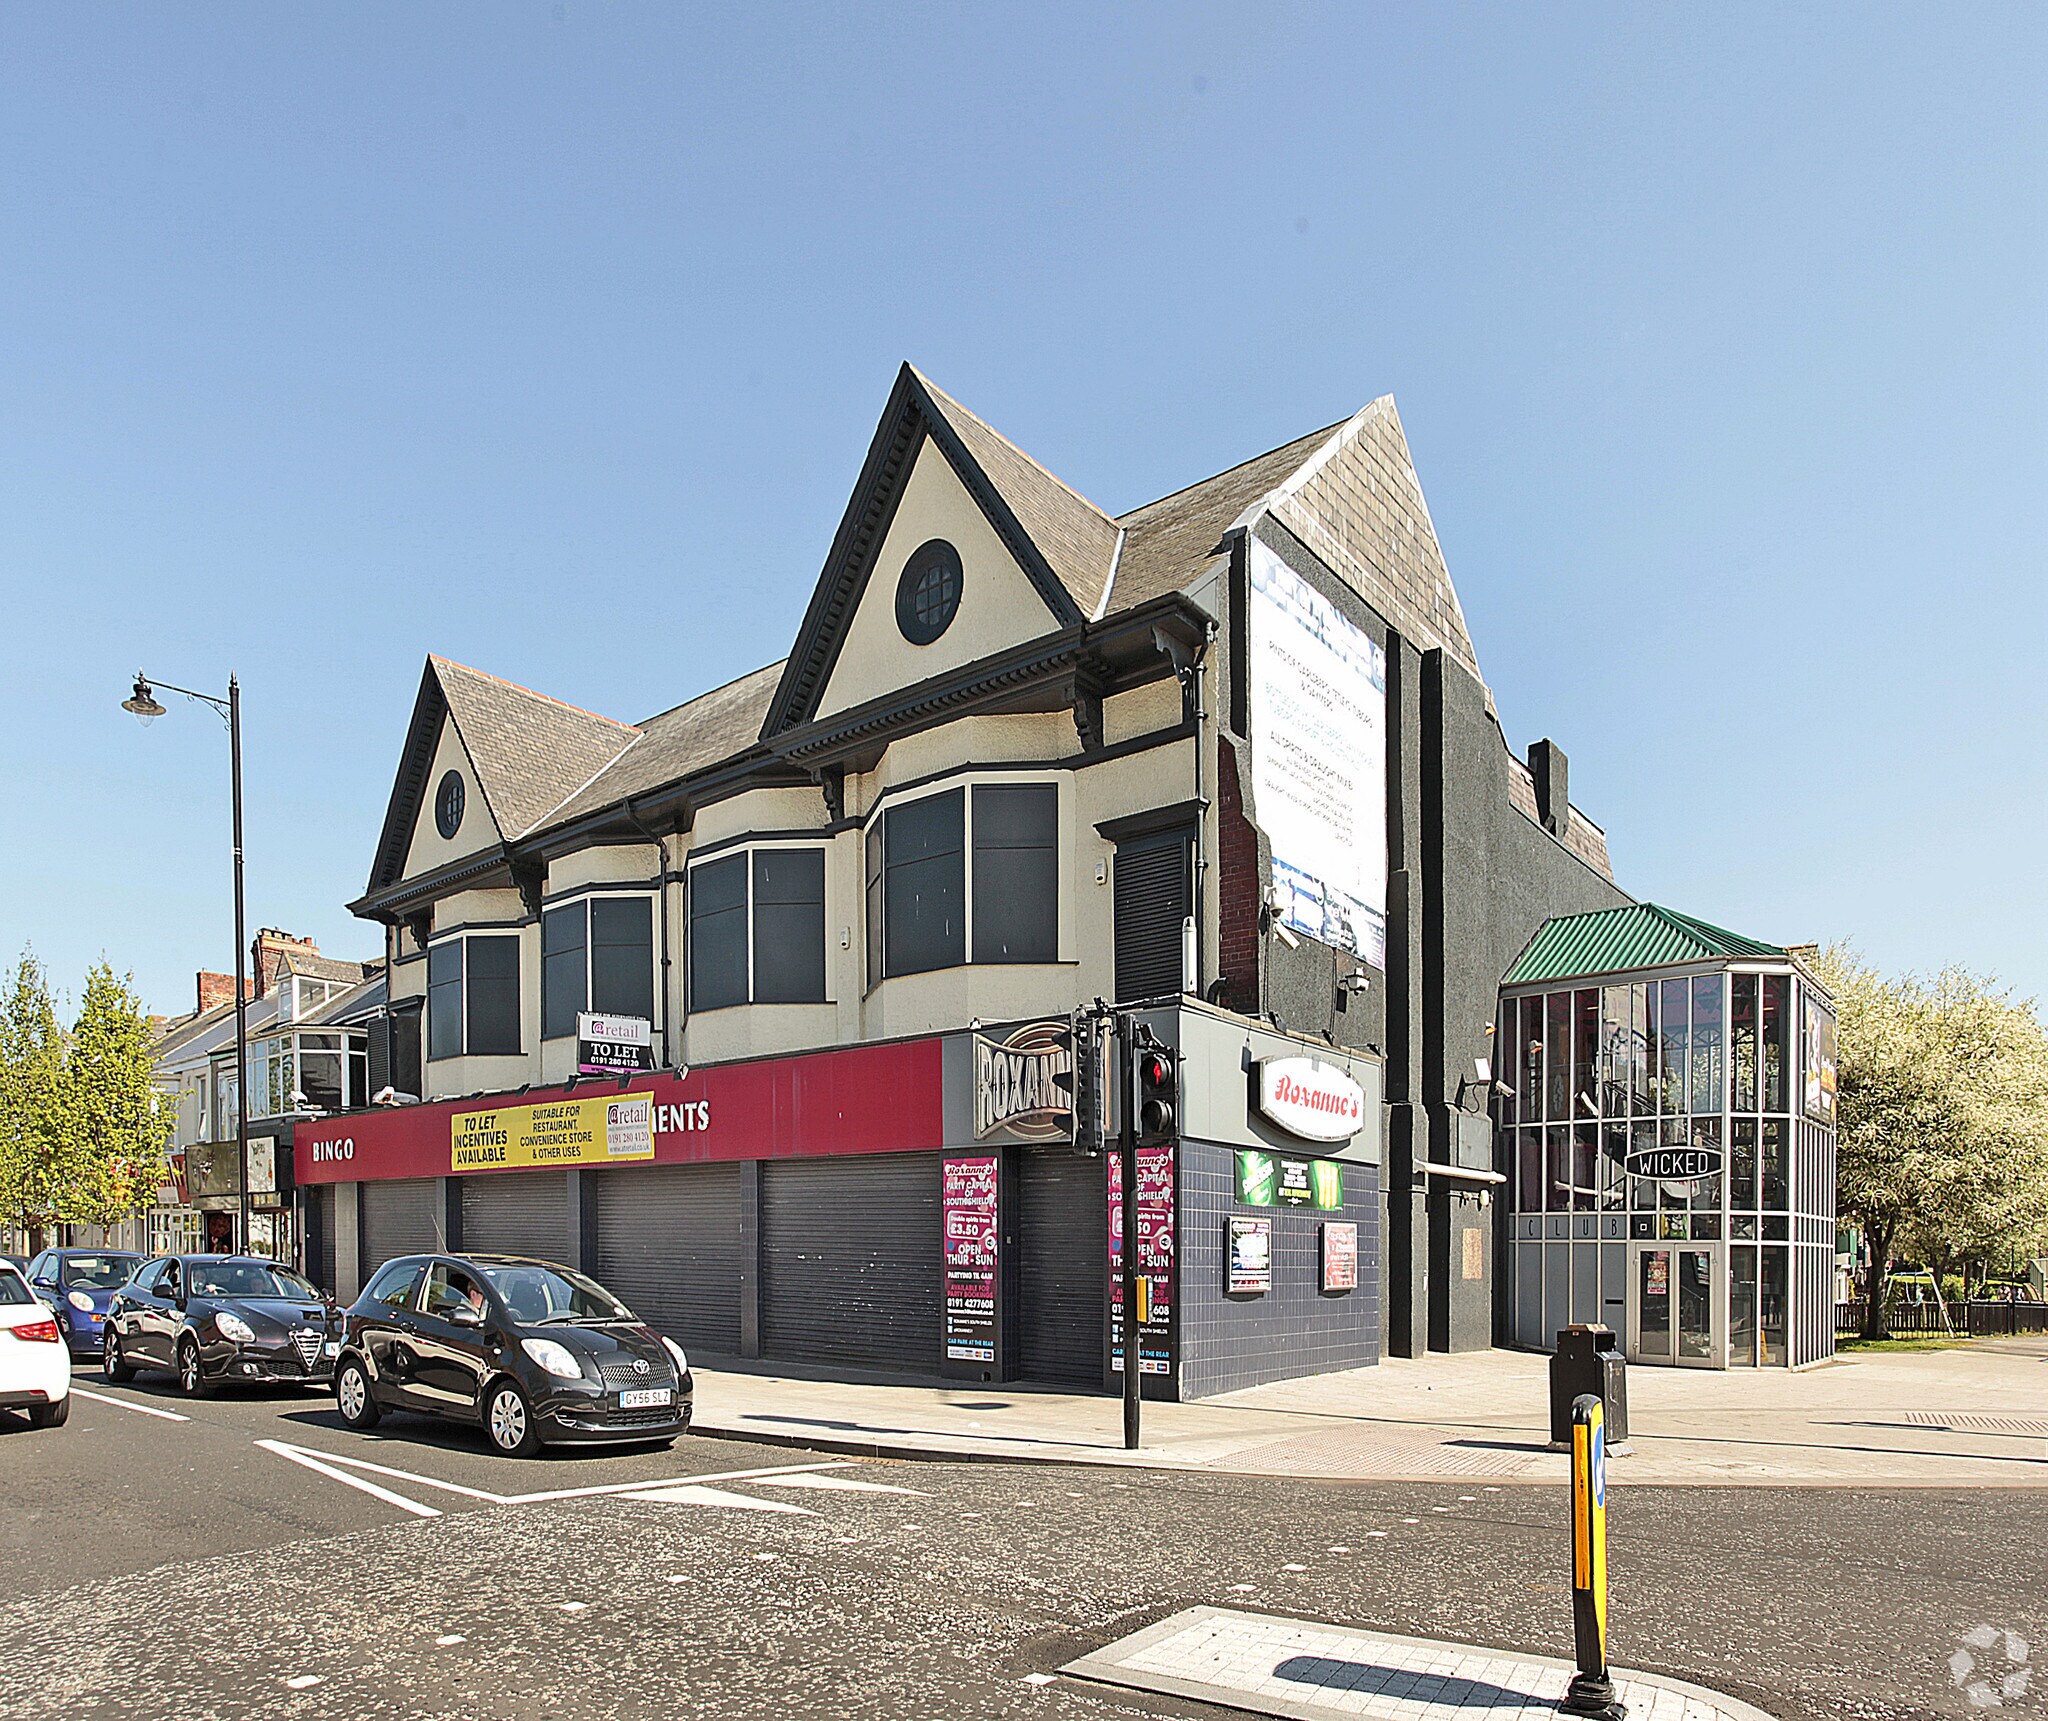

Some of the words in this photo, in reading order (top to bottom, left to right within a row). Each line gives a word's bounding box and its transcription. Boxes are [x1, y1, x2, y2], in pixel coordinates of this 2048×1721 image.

[592, 1020, 639, 1038] @retail
[591, 1042, 611, 1056] TO
[614, 1045, 639, 1058] LET
[591, 1056, 608, 1064] 0191
[609, 1057, 621, 1066] 280
[622, 1058, 639, 1067] 4120
[1275, 1075, 1360, 1118] Roxanne's
[532, 1108, 564, 1121] SUITABLE
[565, 1106, 581, 1117] FOR
[608, 1102, 648, 1125] @retail
[464, 1117, 476, 1131] TO
[479, 1115, 497, 1130] LET
[454, 1130, 508, 1149] INCENTIVES
[519, 1133, 567, 1147] CONVENIENCE
[568, 1131, 593, 1144] STORE
[608, 1133, 622, 1143] 0191
[312, 1138, 354, 1162] BINGO
[457, 1147, 506, 1164] AVAILABLE
[532, 1149, 537, 1159] &
[538, 1147, 561, 1158] OTHER
[562, 1146, 582, 1158] USES
[1639, 1152, 1709, 1175] WICKED
[947, 1181, 966, 1190] PARTY
[965, 1190, 974, 1198] OF
[950, 1223, 978, 1236] £3.50
[958, 1244, 982, 1255] OPEN
[947, 1254, 969, 1265] THUR
[975, 1254, 994, 1266] SUN
[1146, 1255, 1169, 1267] SUN
[947, 1298, 963, 1307] 0191
[626, 1393, 650, 1405] GY56
